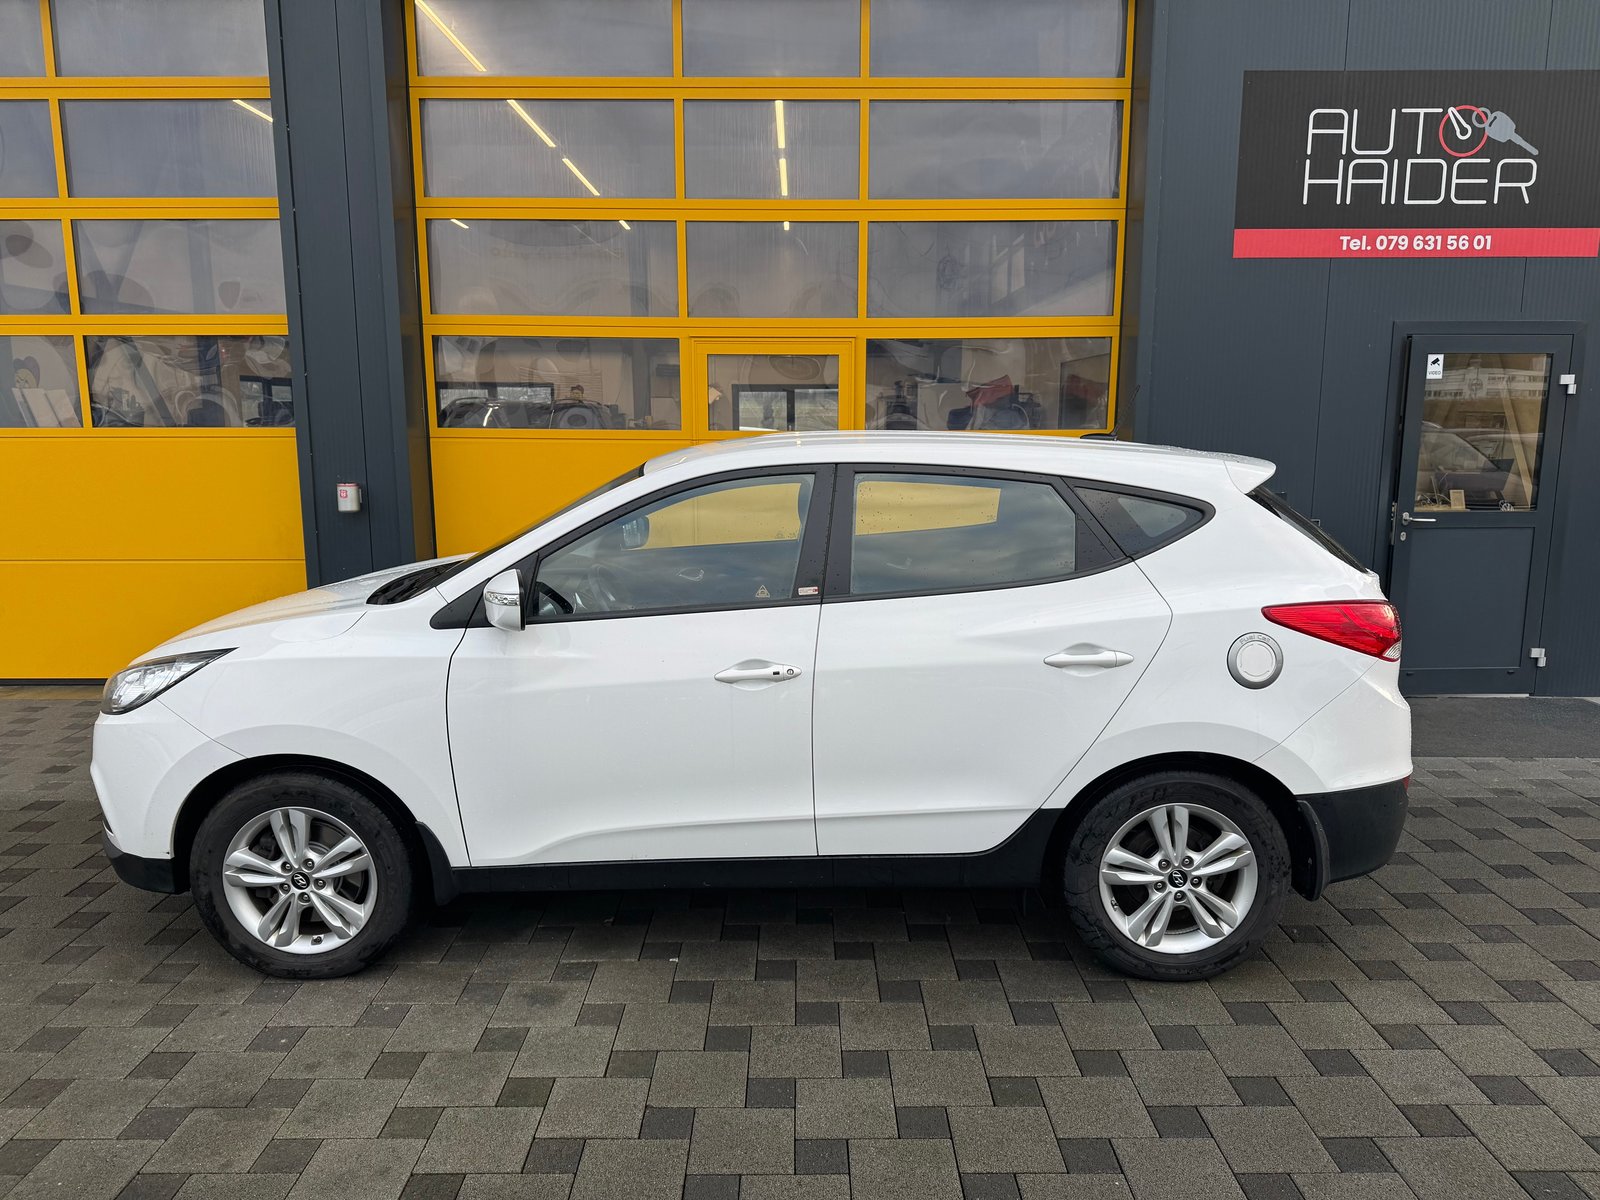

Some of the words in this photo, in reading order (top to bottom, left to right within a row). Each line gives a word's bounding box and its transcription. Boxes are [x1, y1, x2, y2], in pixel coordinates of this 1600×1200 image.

[1302, 158, 1538, 205] HAIDER
[1339, 235, 1371, 251] Tel.
[1375, 235, 1409, 251] 079
[1413, 235, 1442, 251] 631
[1446, 235, 1469, 251] 56
[1473, 235, 1492, 251] 01
